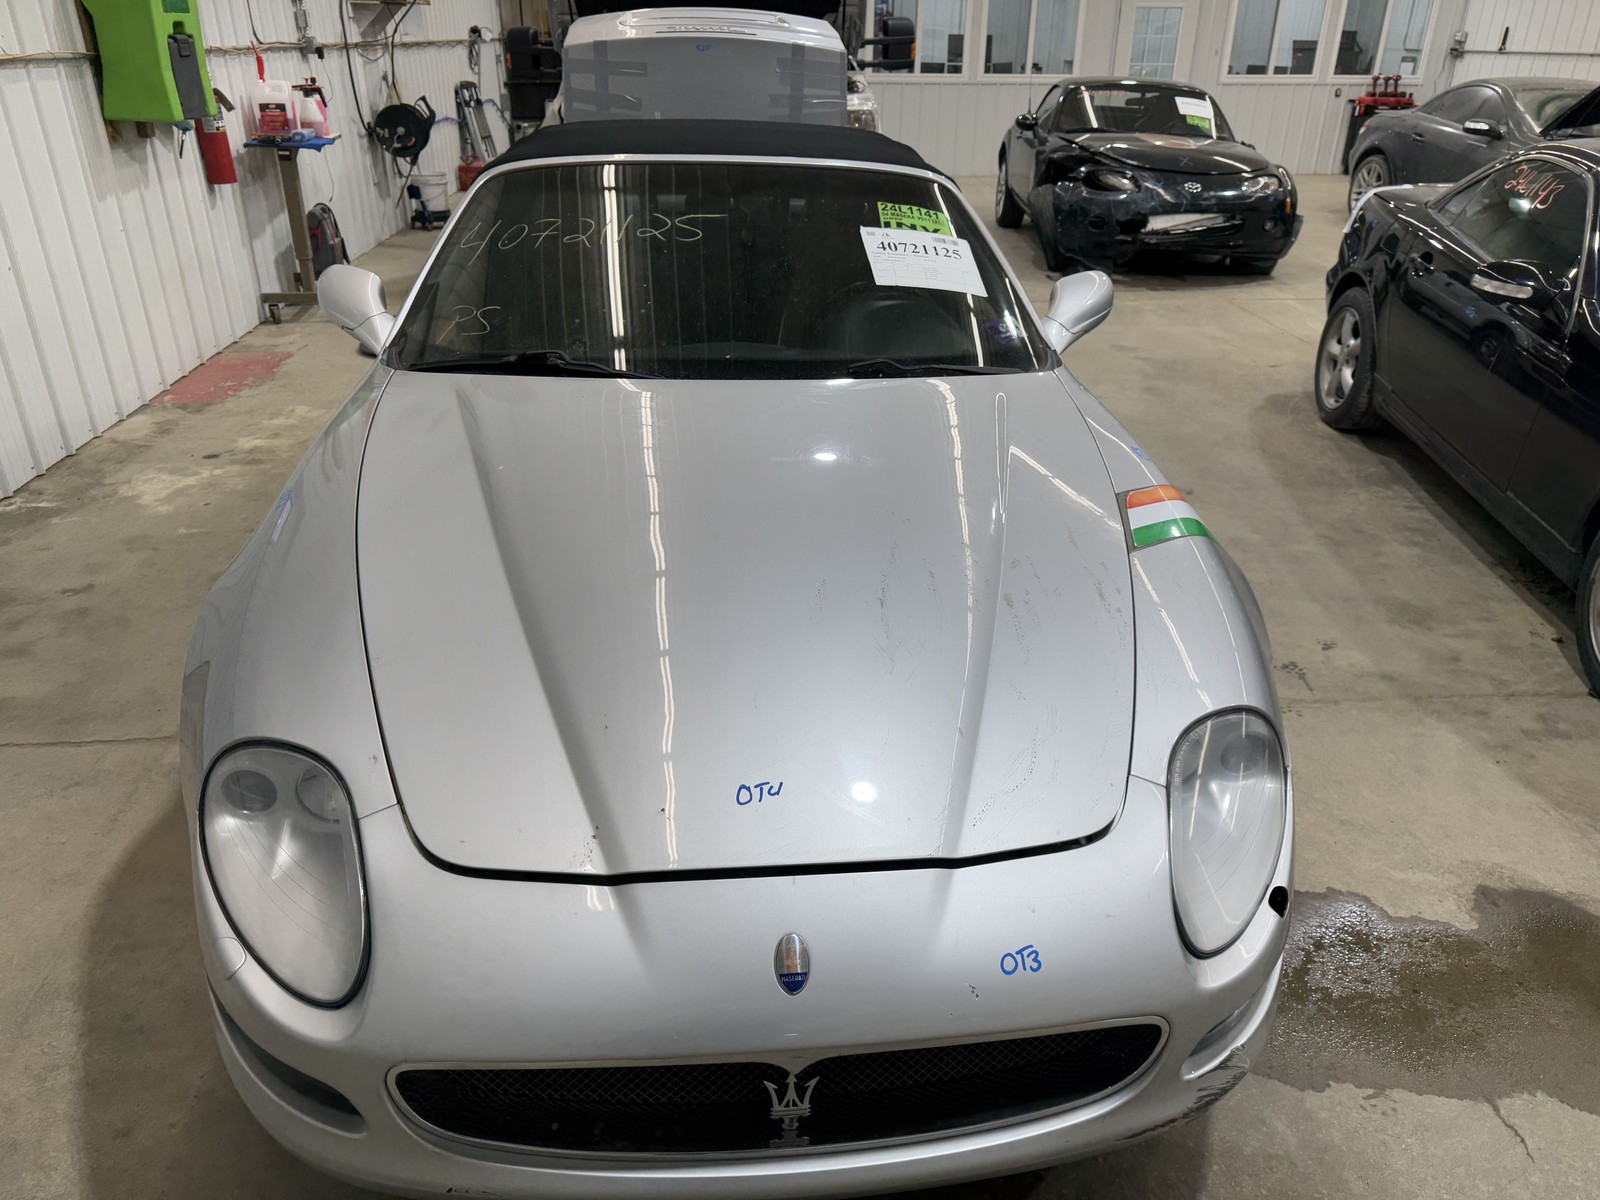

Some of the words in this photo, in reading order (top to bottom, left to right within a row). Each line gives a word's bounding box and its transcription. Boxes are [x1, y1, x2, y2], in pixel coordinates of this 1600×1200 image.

[880, 203, 939, 219] 24L1141
[877, 241, 962, 260] 40721125
[1000, 944, 1042, 976] OT3
